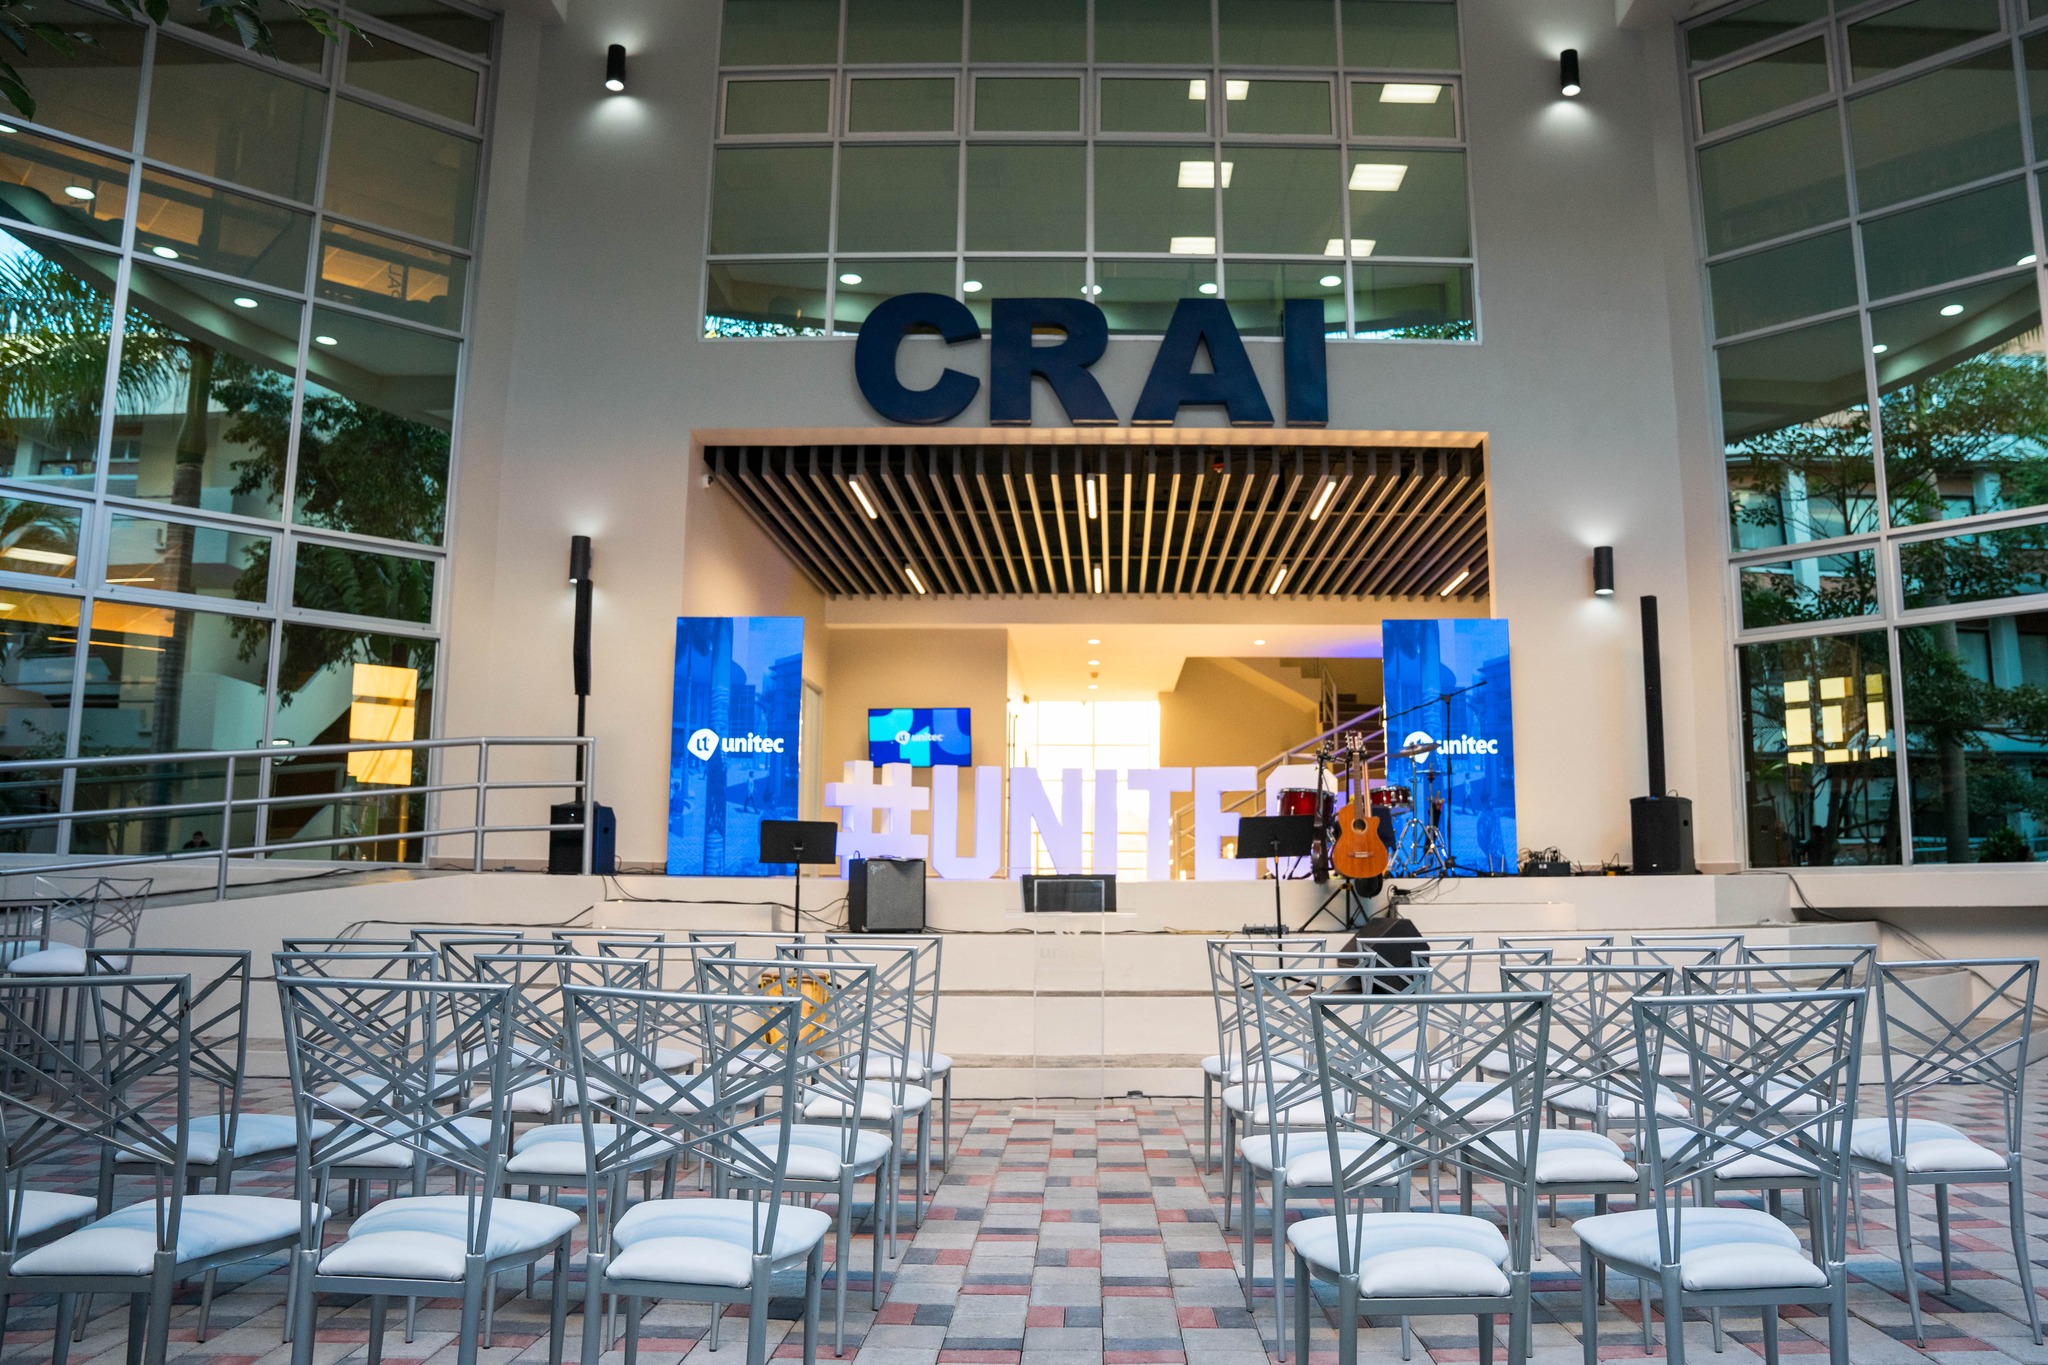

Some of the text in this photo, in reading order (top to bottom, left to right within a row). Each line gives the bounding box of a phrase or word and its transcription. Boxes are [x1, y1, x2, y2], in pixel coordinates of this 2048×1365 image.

[855, 292, 1328, 427] CRAI
[721, 732, 784, 753] unitec
[1436, 734, 1498, 755] unitec
